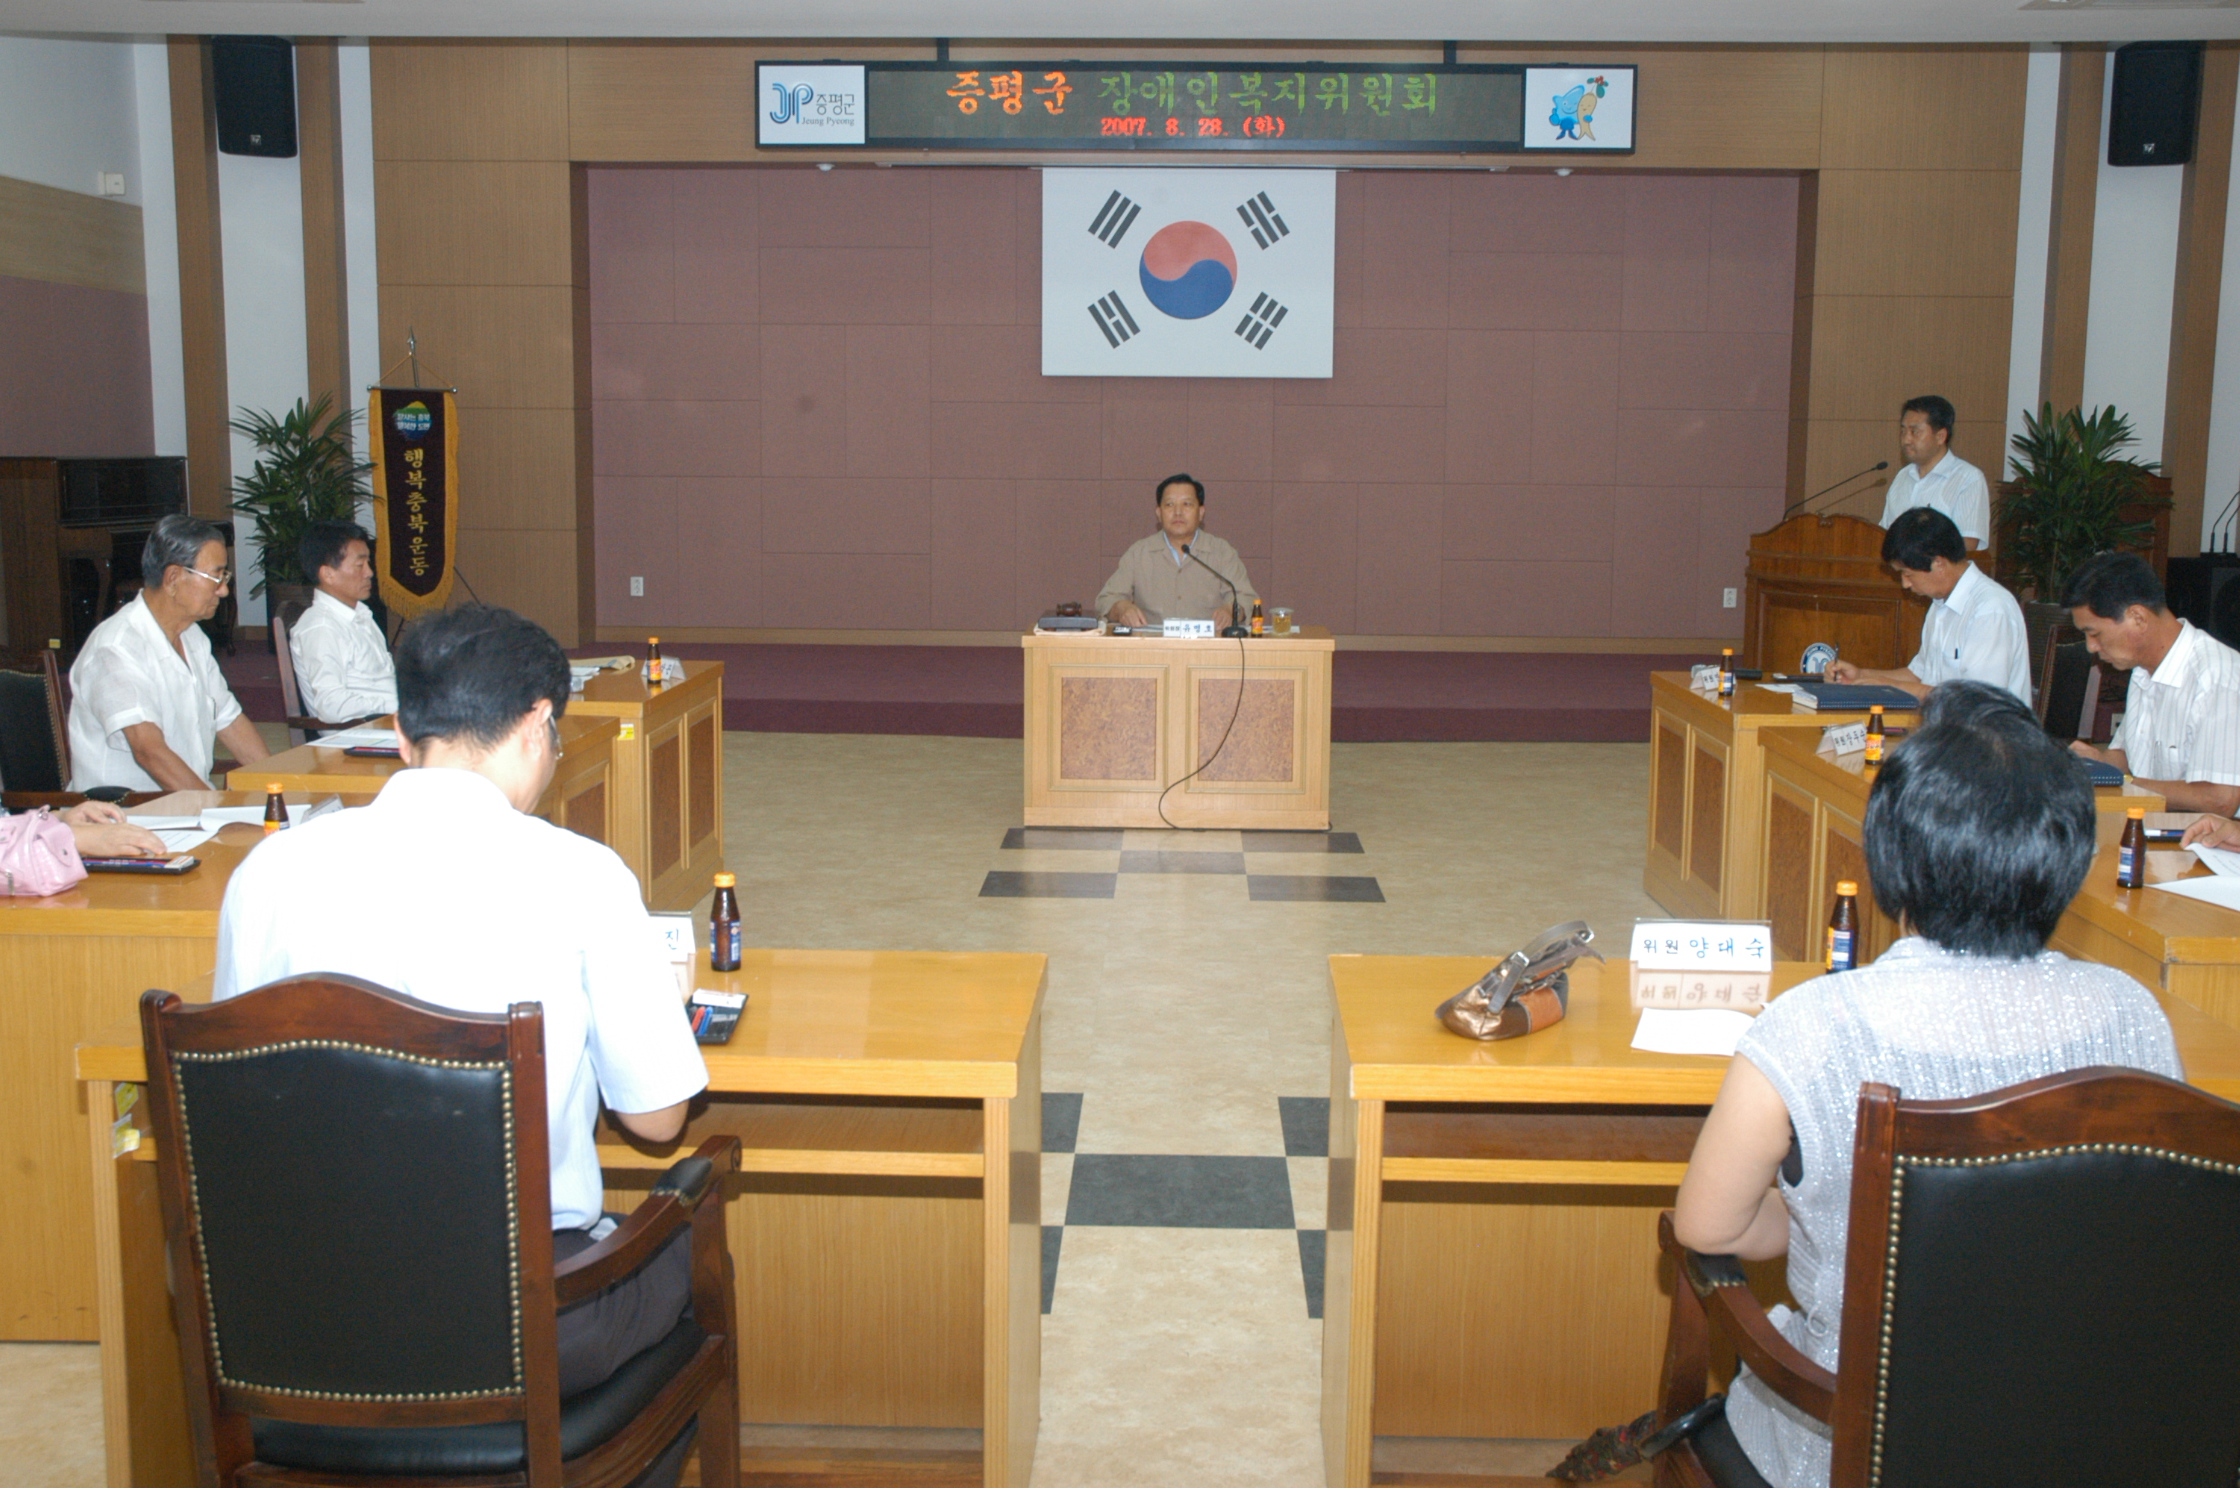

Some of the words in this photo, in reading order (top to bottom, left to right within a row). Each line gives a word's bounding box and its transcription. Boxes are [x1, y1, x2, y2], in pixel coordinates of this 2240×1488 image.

[816, 93, 855, 116] 증평군
[947, 70, 1073, 116] 증평군
[801, 117, 825, 127] Jeung
[826, 116, 855, 127] Pyeong
[1101, 116, 1153, 137] 2007.
[1165, 117, 1186, 137] 8.
[1197, 117, 1229, 137] 28.
[1242, 114, 1286, 138] (화)
[1643, 939, 1678, 954] 위원
